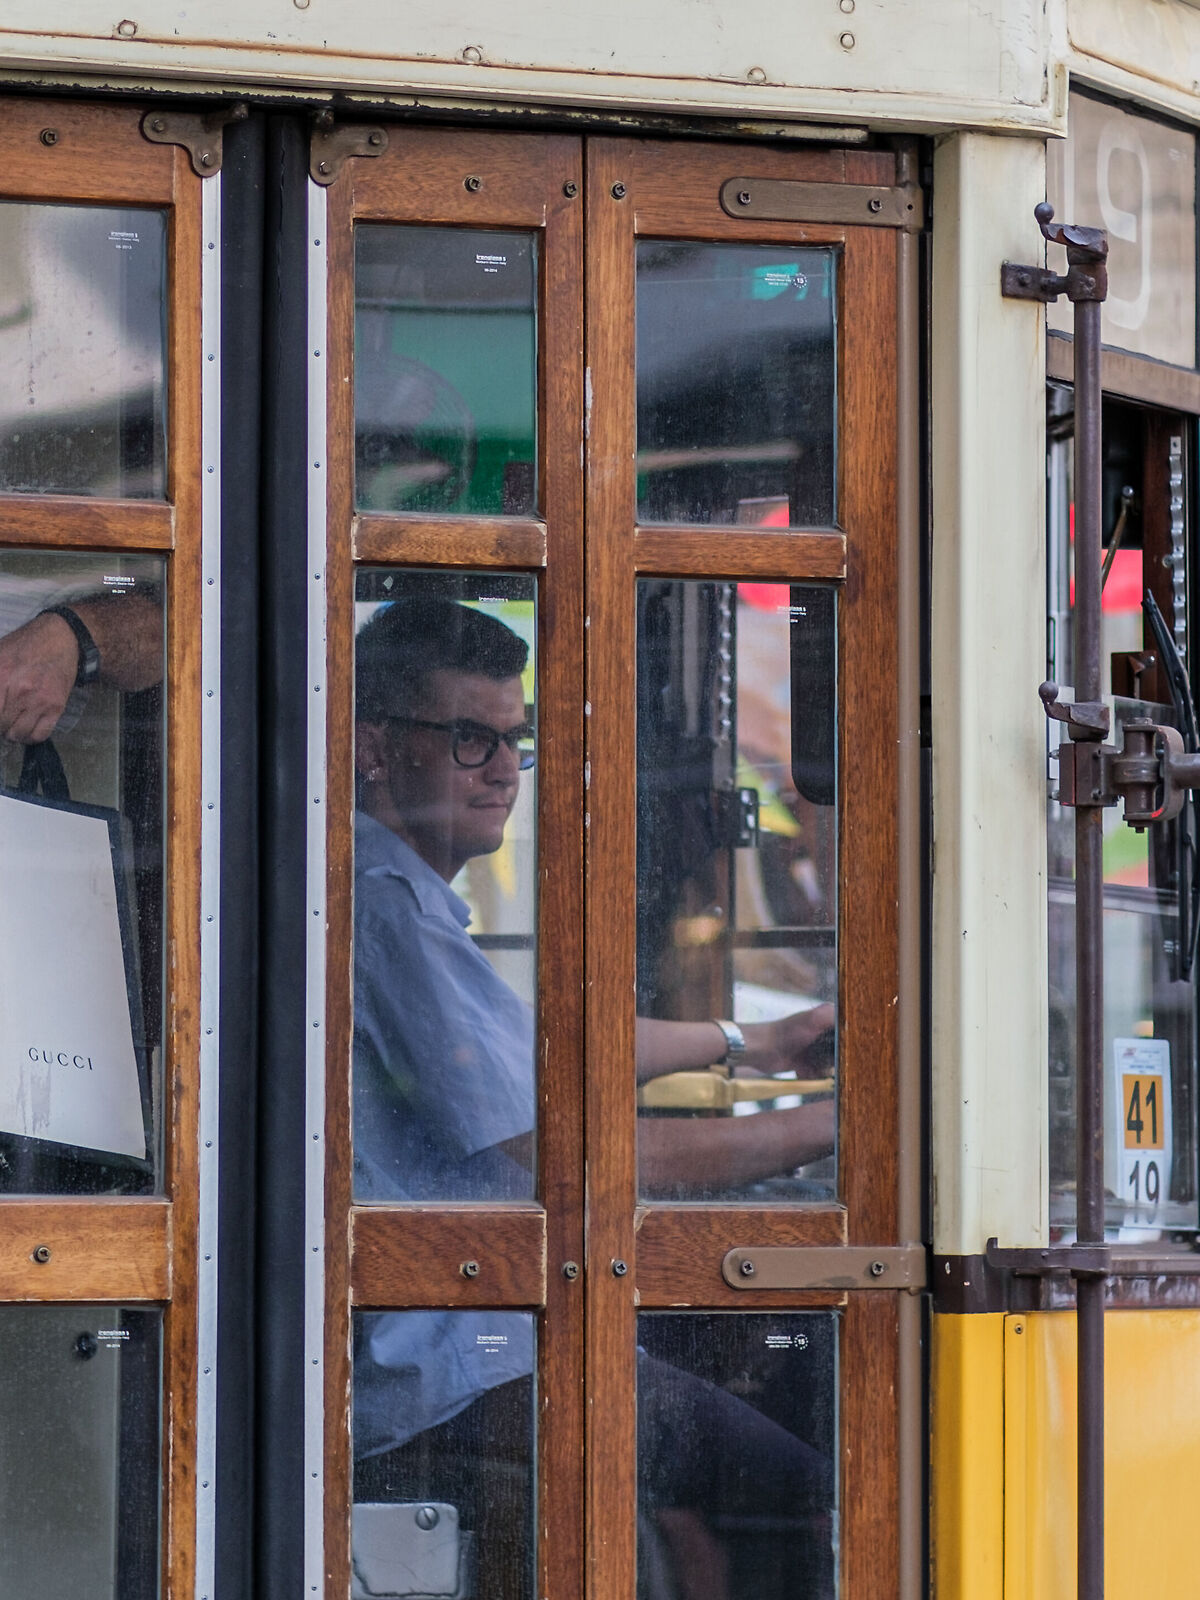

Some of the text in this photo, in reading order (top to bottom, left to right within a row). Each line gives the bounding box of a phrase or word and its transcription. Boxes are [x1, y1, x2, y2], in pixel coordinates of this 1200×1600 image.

[28, 1047, 93, 1071] GUCCI
[1126, 1080, 1158, 1145] 41
[1129, 1160, 1160, 1224] 19
